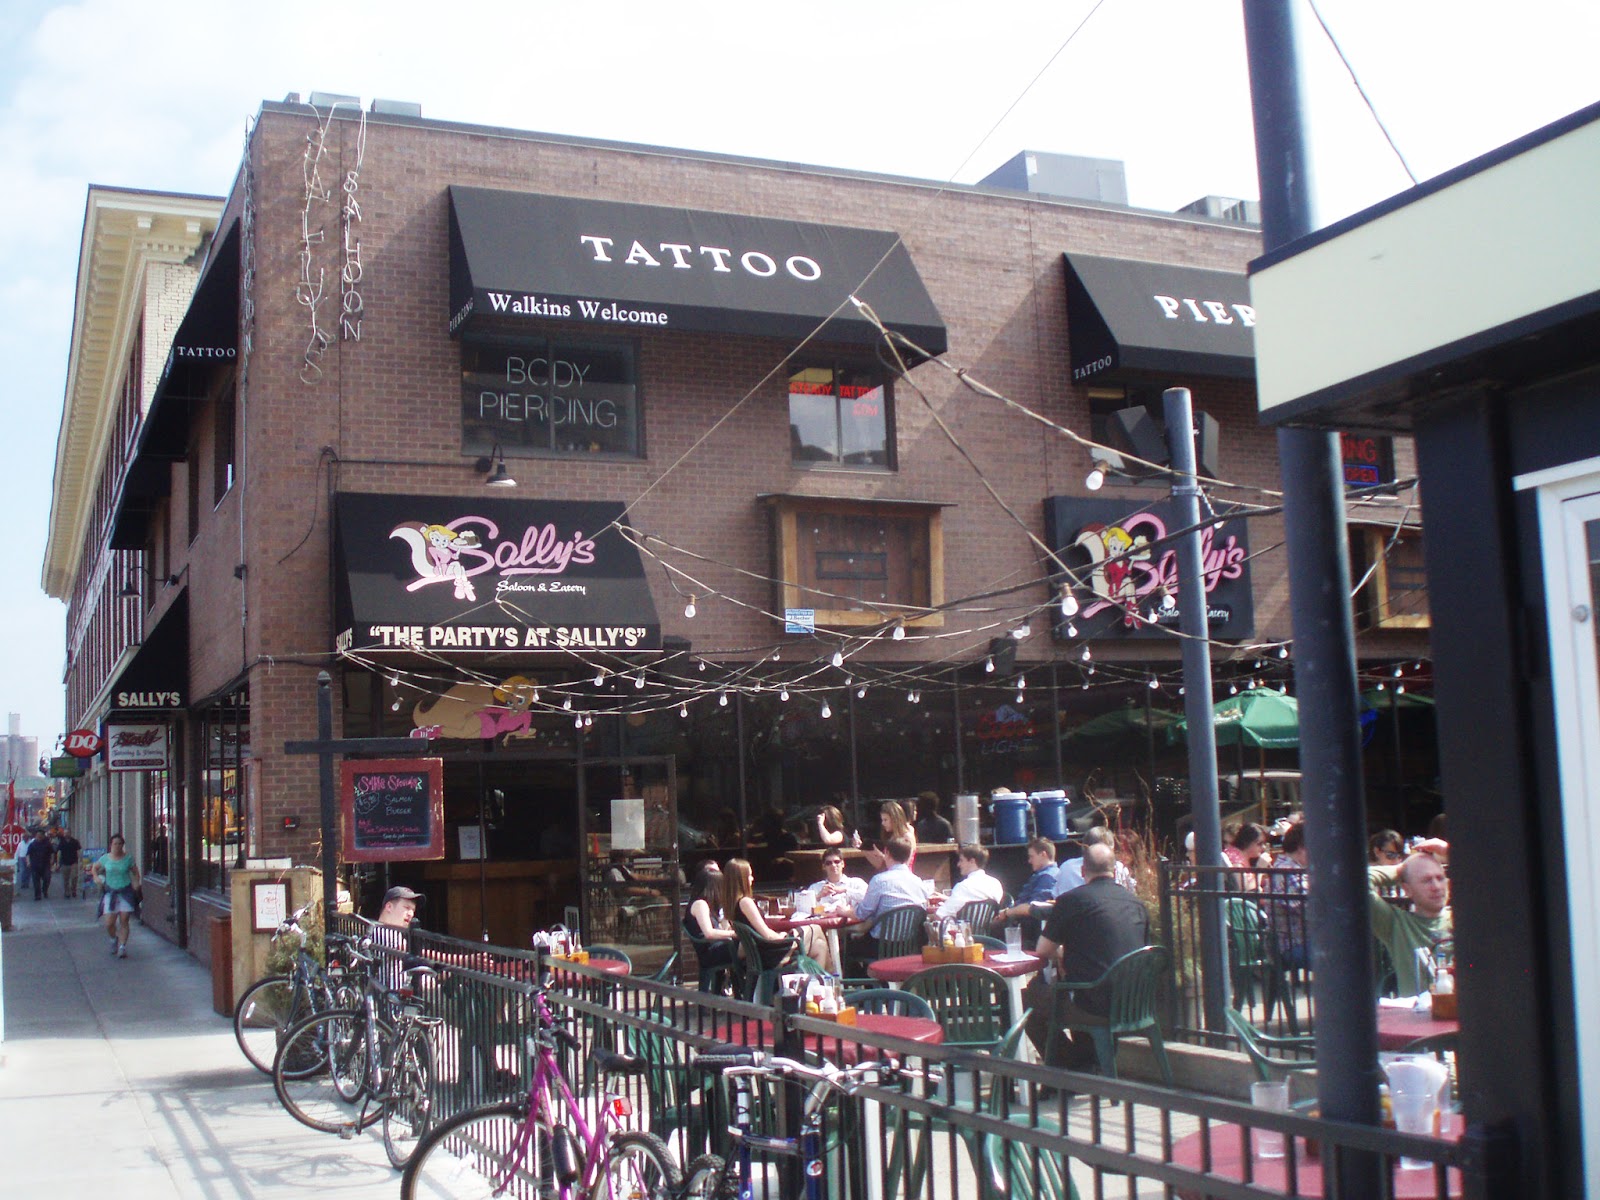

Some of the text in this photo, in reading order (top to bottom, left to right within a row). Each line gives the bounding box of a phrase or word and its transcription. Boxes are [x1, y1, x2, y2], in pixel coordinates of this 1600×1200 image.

[580, 235, 822, 281] TATTOO
[487, 292, 668, 325] Walkins Welcome
[177, 346, 236, 357] TATTOO
[1074, 355, 1112, 379] TATTOO
[480, 391, 617, 428] PIERCING
[406, 515, 595, 592] Sally's
[1082, 513, 1245, 619] Saly's
[496, 580, 586, 595] Saloon & Eatery
[1157, 605, 1179, 618] Salo
[430, 627, 518, 647] PARTY'S
[524, 627, 550, 646] AT
[118, 692, 180, 707] SALLY'S
[69, 735, 98, 750] DQ
[2, 833, 24, 844] STO
